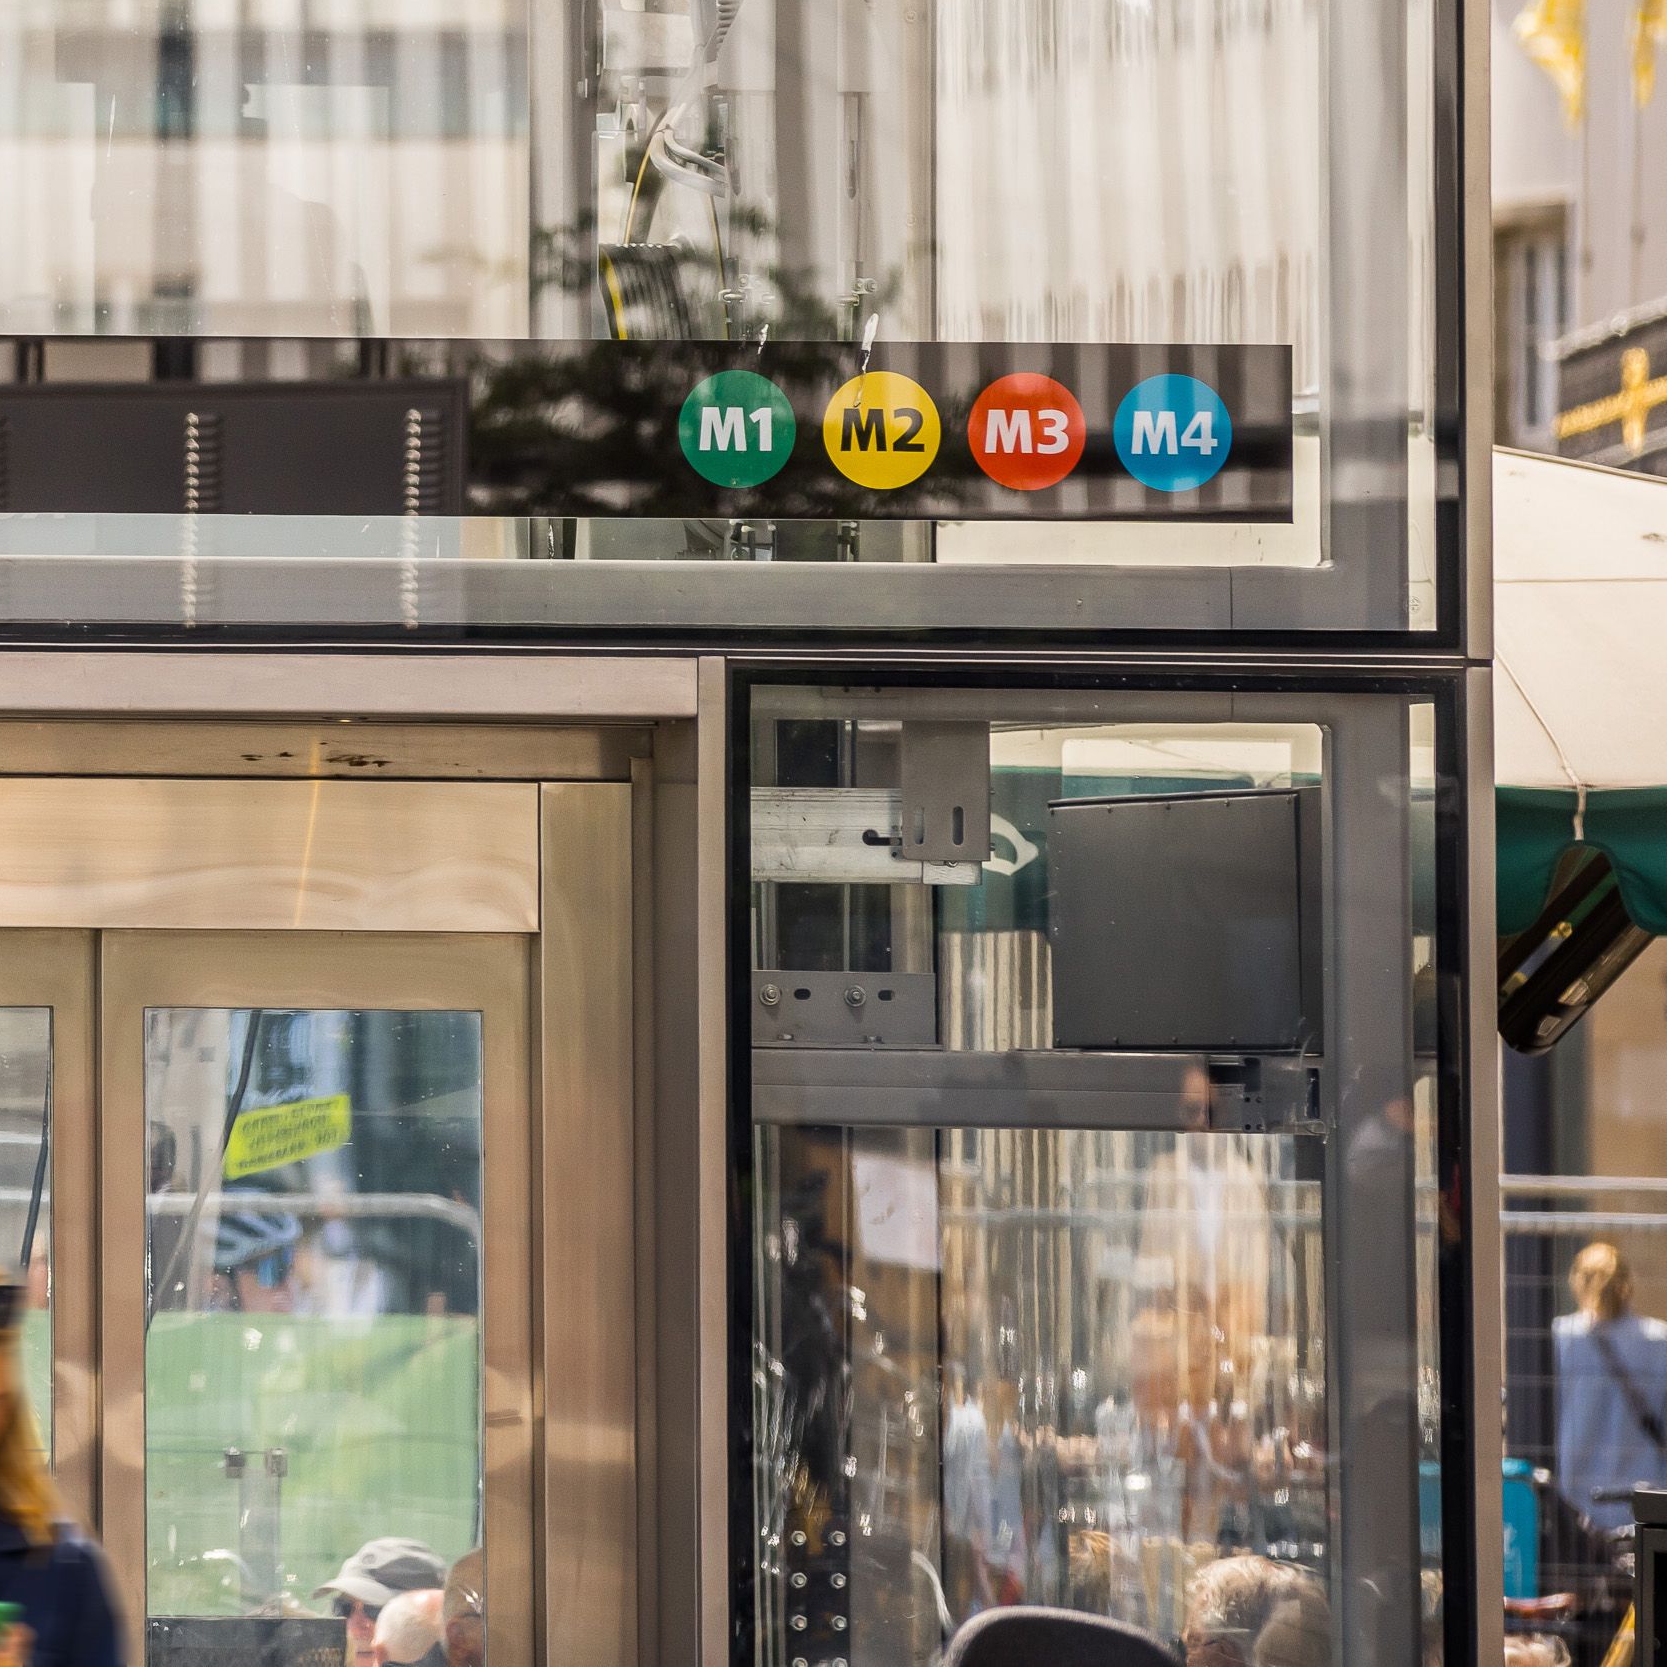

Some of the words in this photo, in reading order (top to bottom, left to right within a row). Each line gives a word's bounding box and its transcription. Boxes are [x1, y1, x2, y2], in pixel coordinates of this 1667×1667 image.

[698, 406, 773, 452] M1
[840, 408, 926, 453] M2
[984, 409, 1069, 455] M3
[1131, 410, 1218, 456] M4
